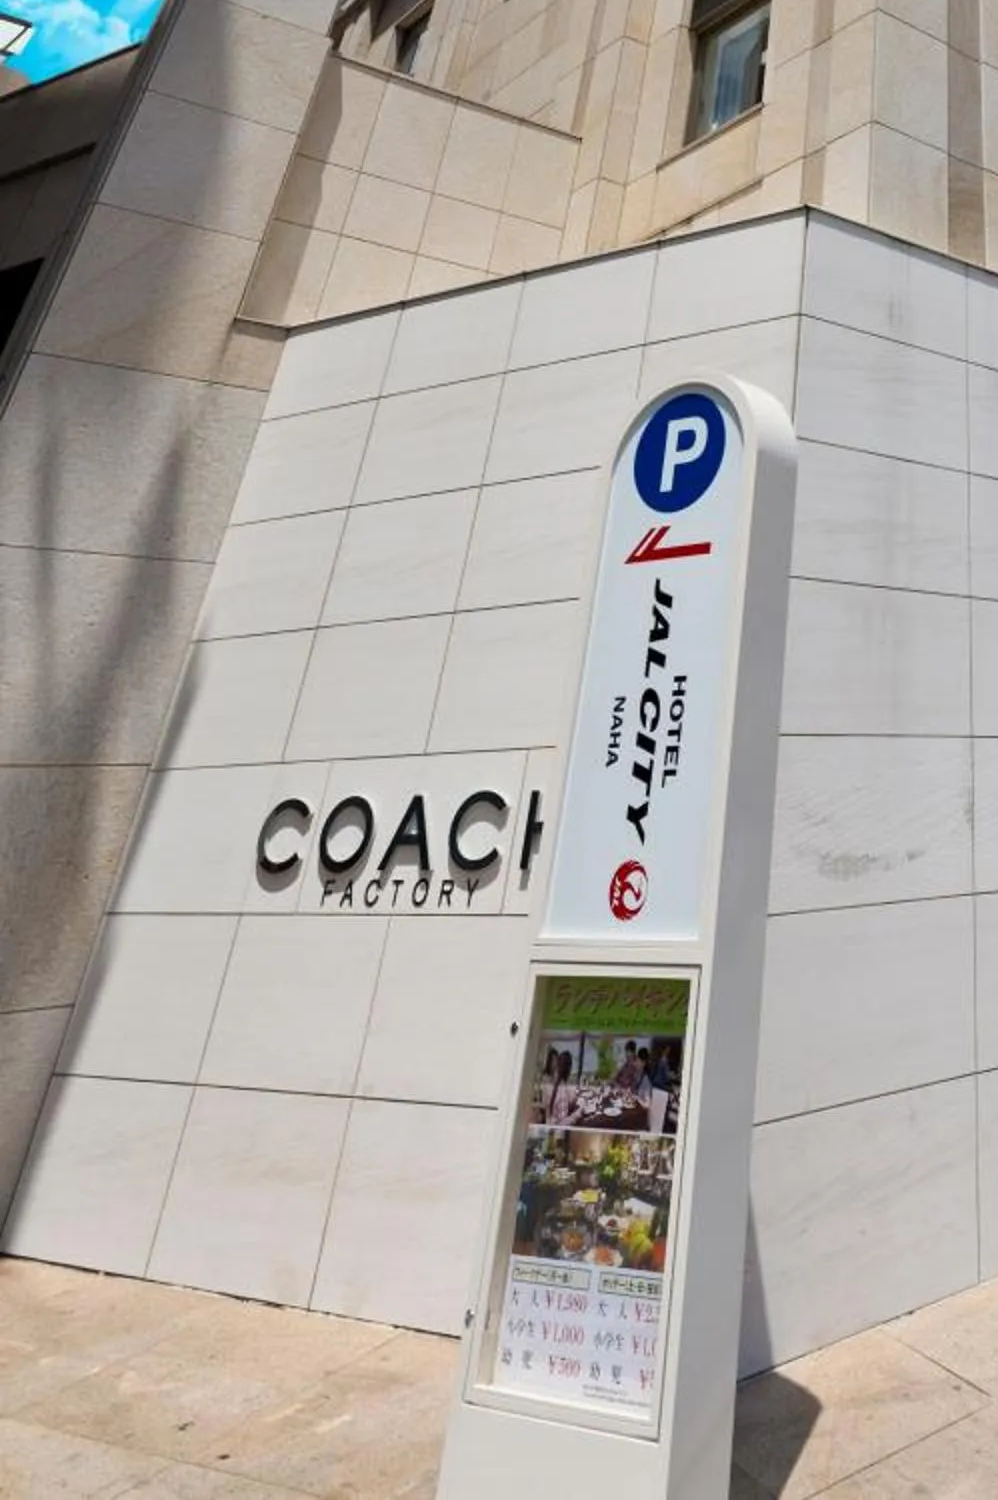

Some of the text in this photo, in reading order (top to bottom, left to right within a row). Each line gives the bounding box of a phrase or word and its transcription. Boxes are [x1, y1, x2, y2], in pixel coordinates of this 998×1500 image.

[659, 416, 709, 493] P
[605, 696, 627, 768] NAHA
[626, 578, 673, 846] JAL CITY
[661, 675, 687, 789] HOTEL
[320, 878, 480, 908] FACTORY
